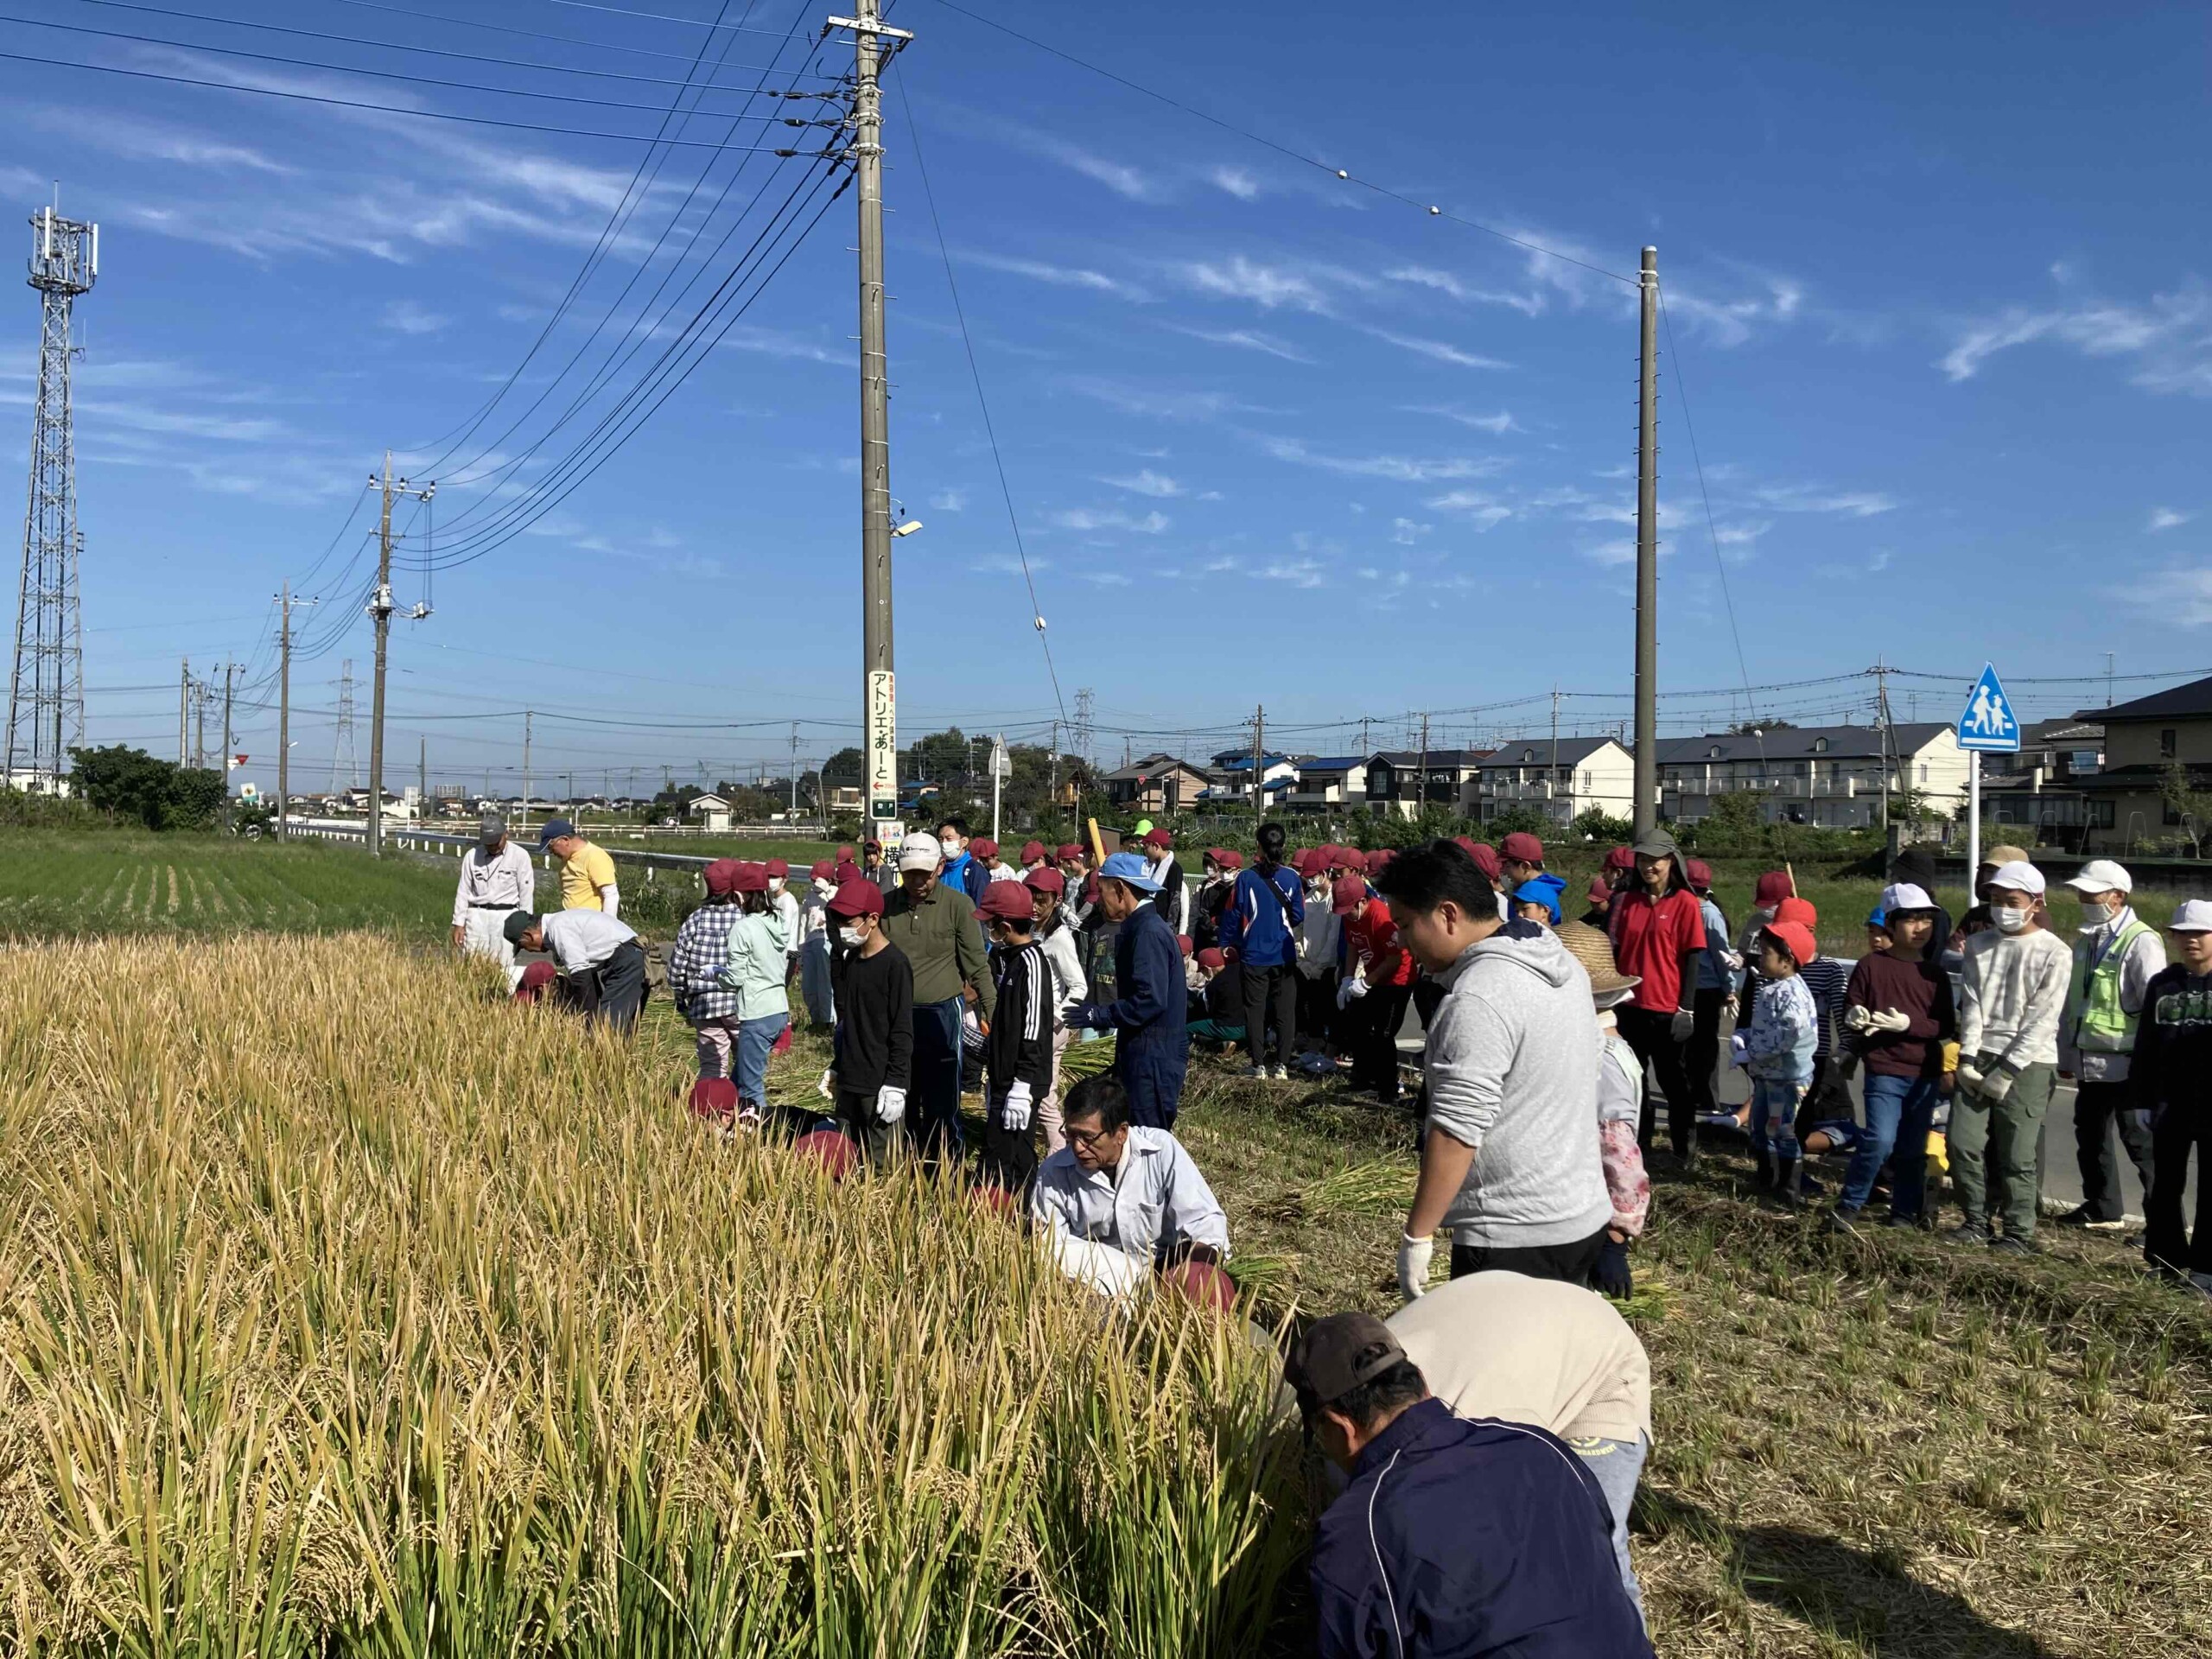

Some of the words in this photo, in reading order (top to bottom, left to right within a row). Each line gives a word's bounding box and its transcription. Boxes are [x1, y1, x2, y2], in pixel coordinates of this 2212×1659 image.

[874, 673, 887, 779] アトリエ・あーと
